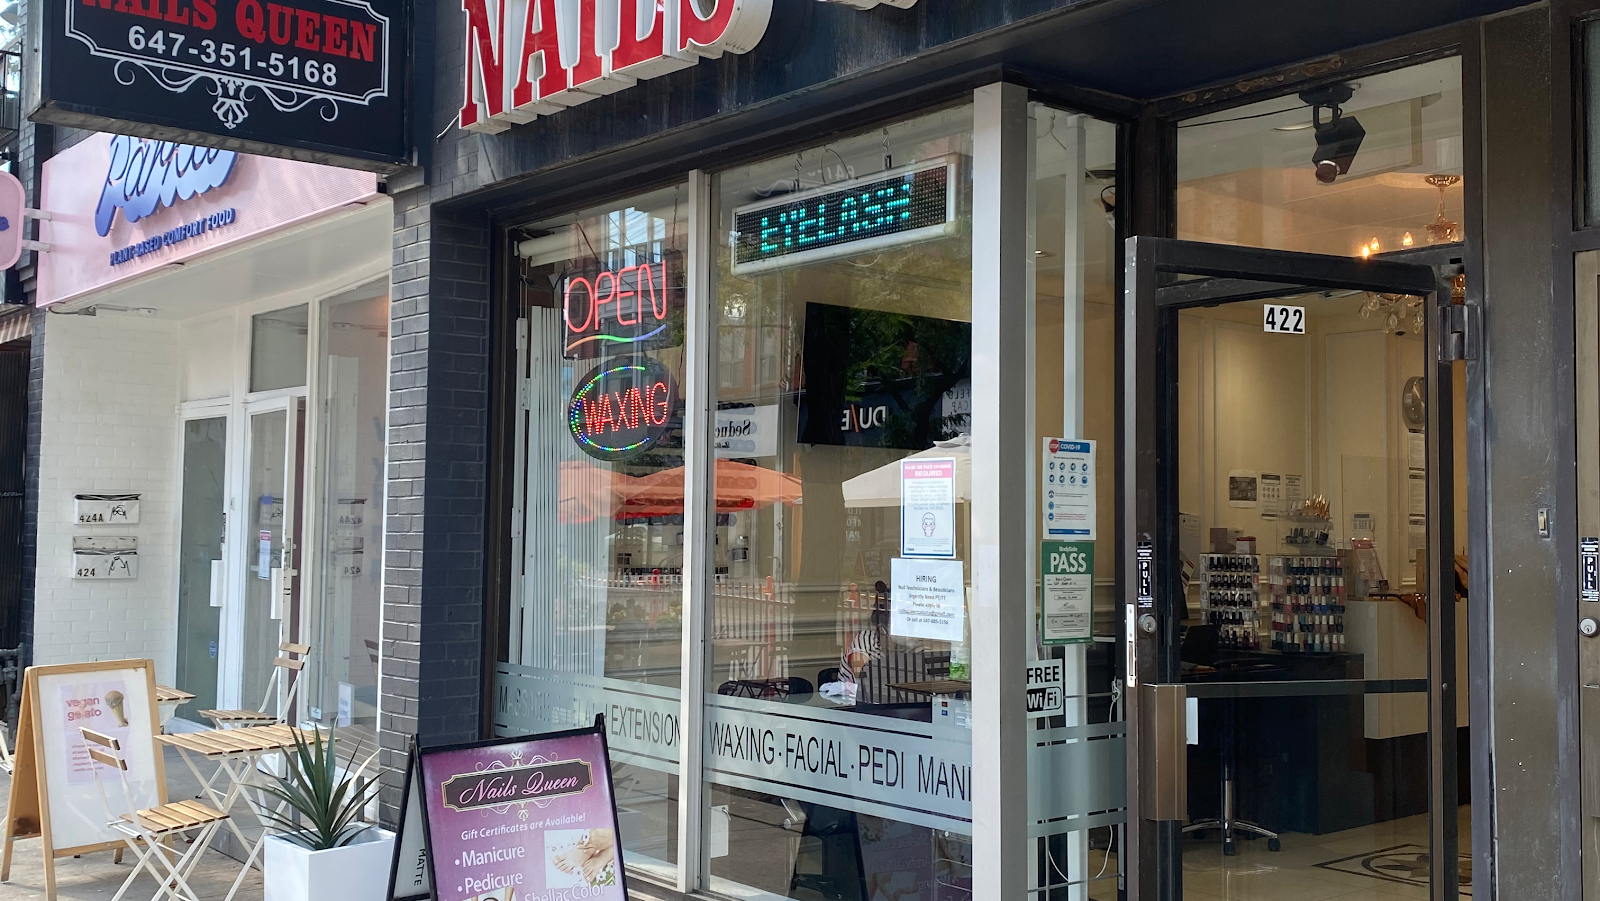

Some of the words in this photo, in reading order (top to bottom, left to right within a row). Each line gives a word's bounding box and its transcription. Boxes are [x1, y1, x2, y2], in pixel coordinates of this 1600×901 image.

[235, 0, 377, 62] QUEEN
[128, 25, 338, 87] 647-351-5168
[110, 235, 163, 266] PLANT-BASED
[162, 217, 207, 246] COMFORT
[207, 207, 236, 230] FOOD
[565, 259, 667, 333] OPEN
[1265, 307, 1304, 332] 422
[583, 382, 668, 436] WAXING
[79, 513, 104, 523] 424A
[77, 568, 96, 577] 424
[1050, 552, 1087, 573] PASS
[915, 575, 937, 583] HIRING
[1026, 665, 1060, 685] FREE
[65, 697, 100, 708] vegan
[708, 720, 775, 766] WAXING
[785, 733, 848, 779] FACIAL
[858, 744, 904, 789] PEDI
[918, 754, 972, 802] MANI
[459, 775, 517, 805] Nails
[521, 771, 578, 795] Queen
[461, 829, 479, 841] Gift
[479, 822, 528, 839] Certificates
[529, 820, 544, 830] are
[544, 812, 586, 827] Available!
[414, 848, 426, 887] MATTE
[462, 844, 526, 868] Manicure
[464, 871, 524, 894] Pedicure
[571, 880, 607, 901] Color
